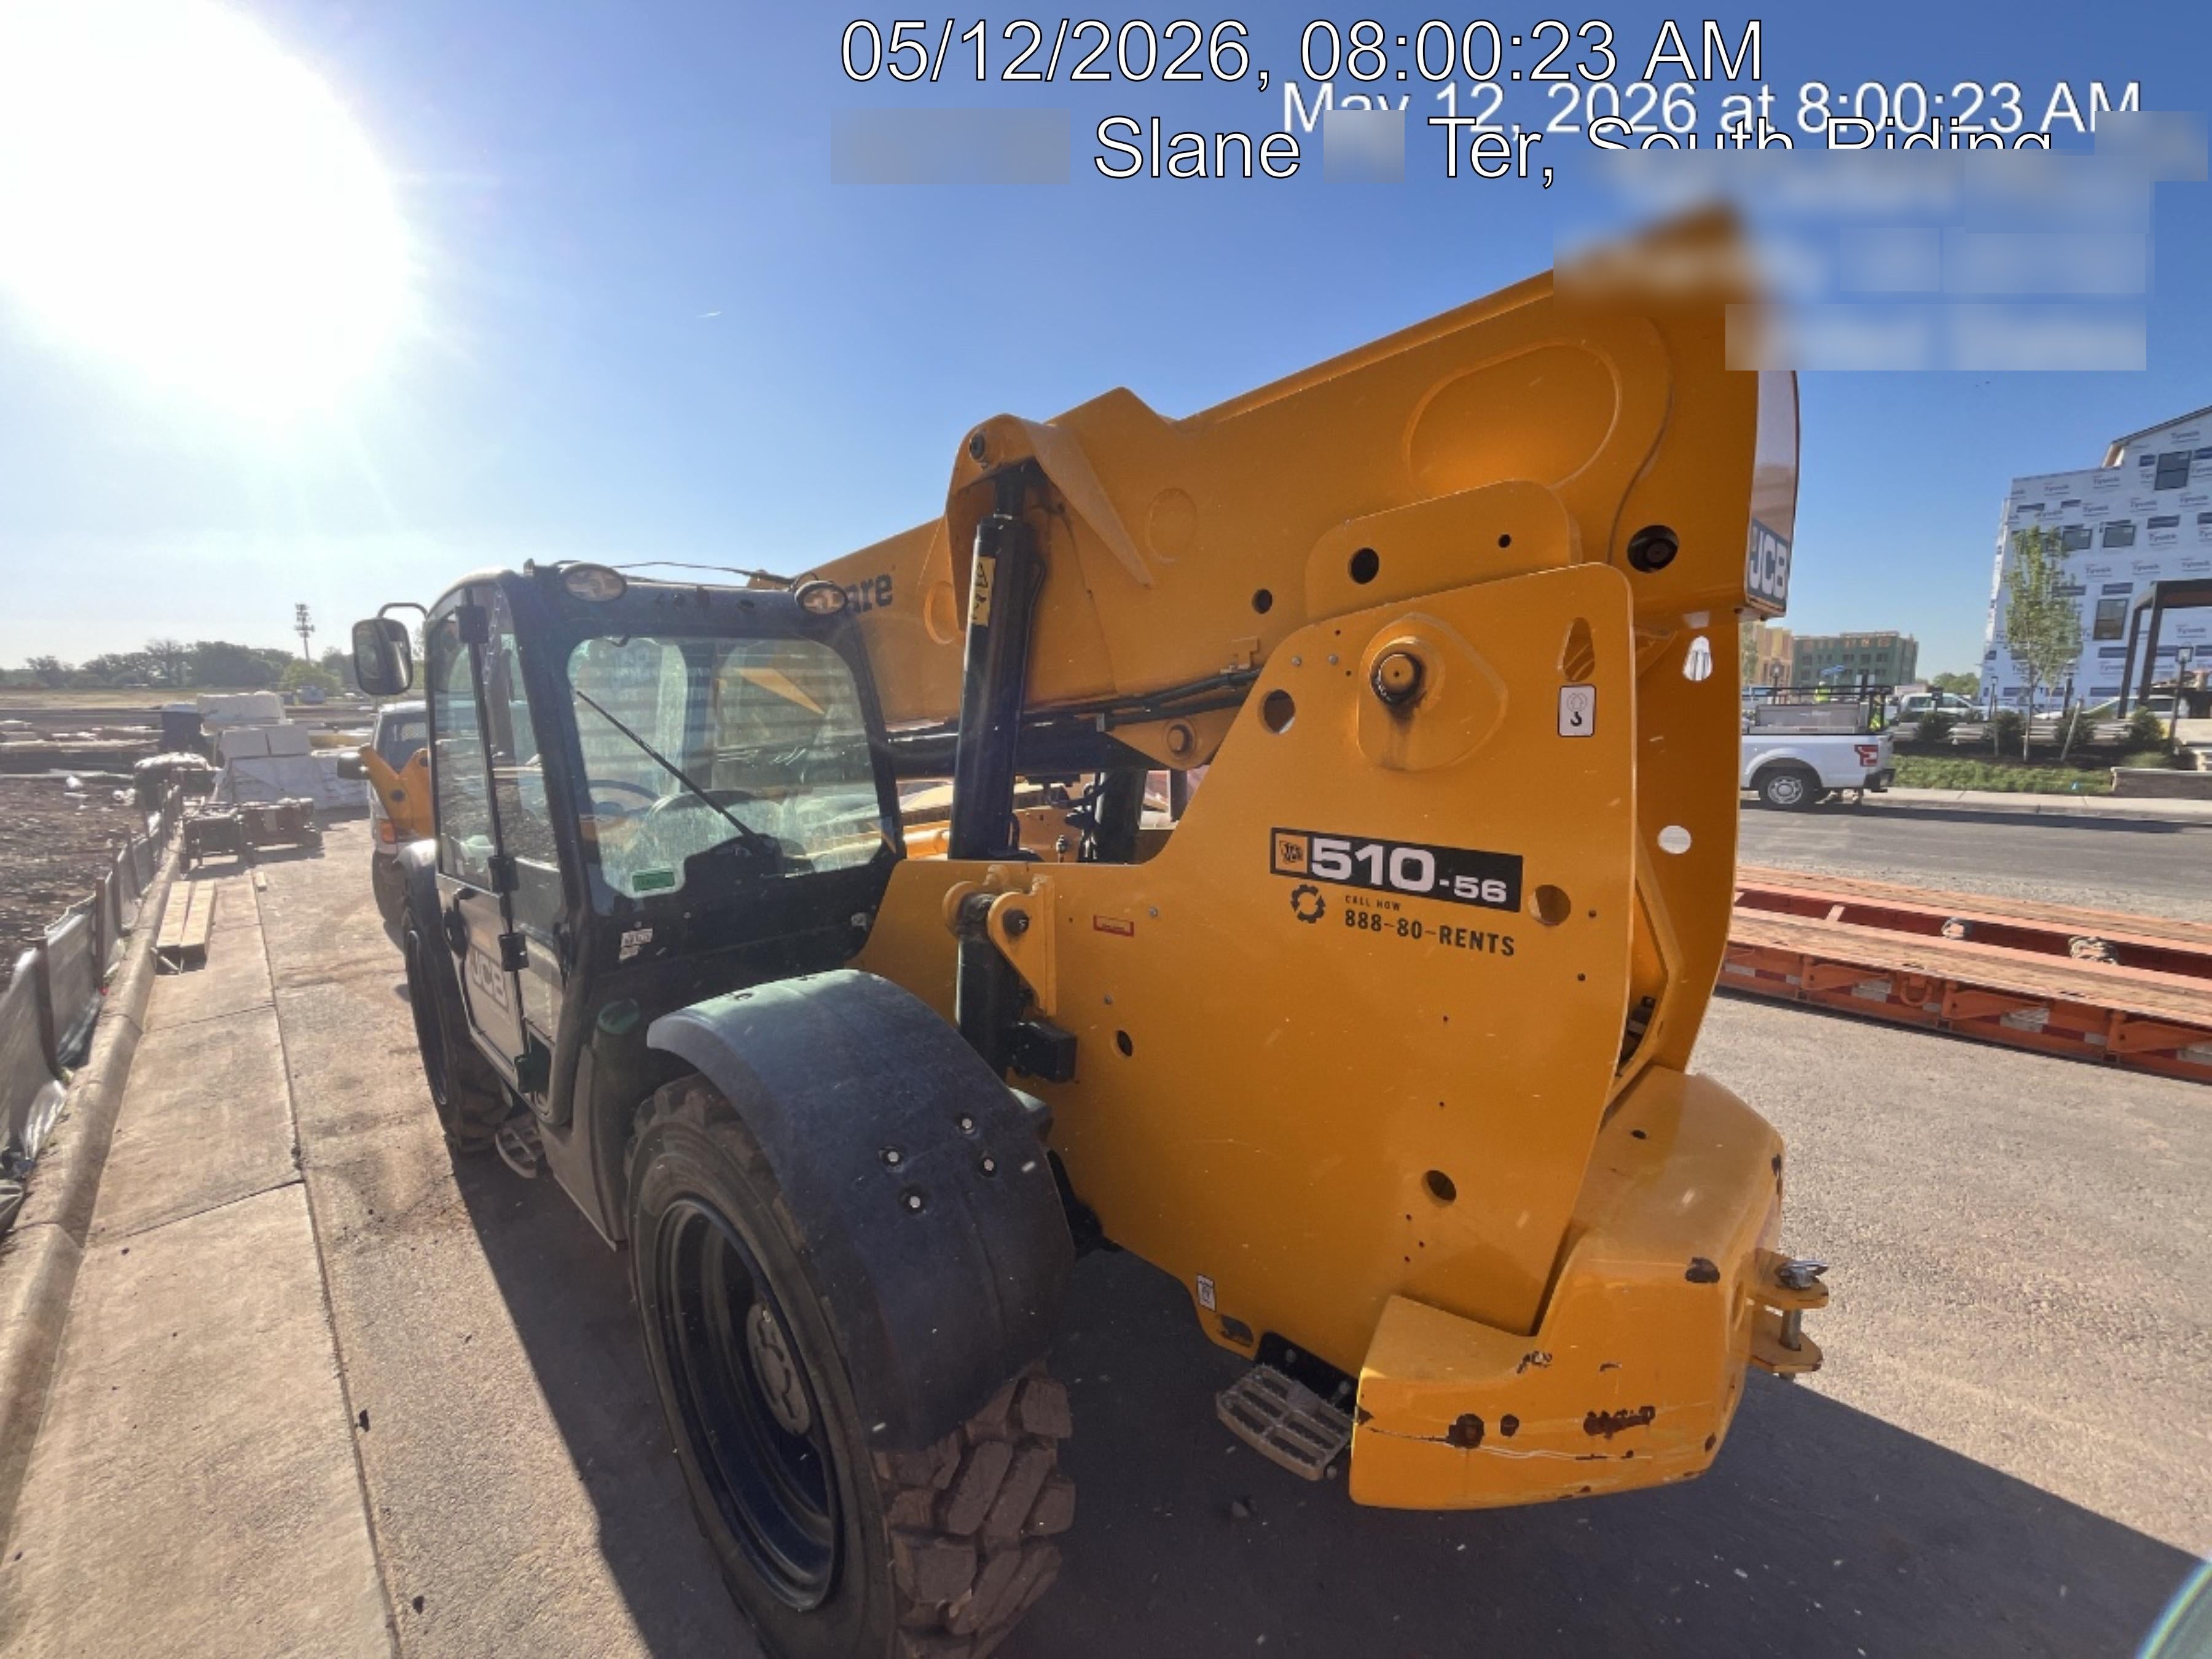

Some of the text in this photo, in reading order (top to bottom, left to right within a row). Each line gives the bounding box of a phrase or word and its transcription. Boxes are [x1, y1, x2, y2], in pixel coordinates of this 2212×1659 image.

[1749, 527, 1788, 600] JCB
[1312, 837, 1507, 903] 510-56
[1345, 909, 1515, 956] 888-80-RENTS
